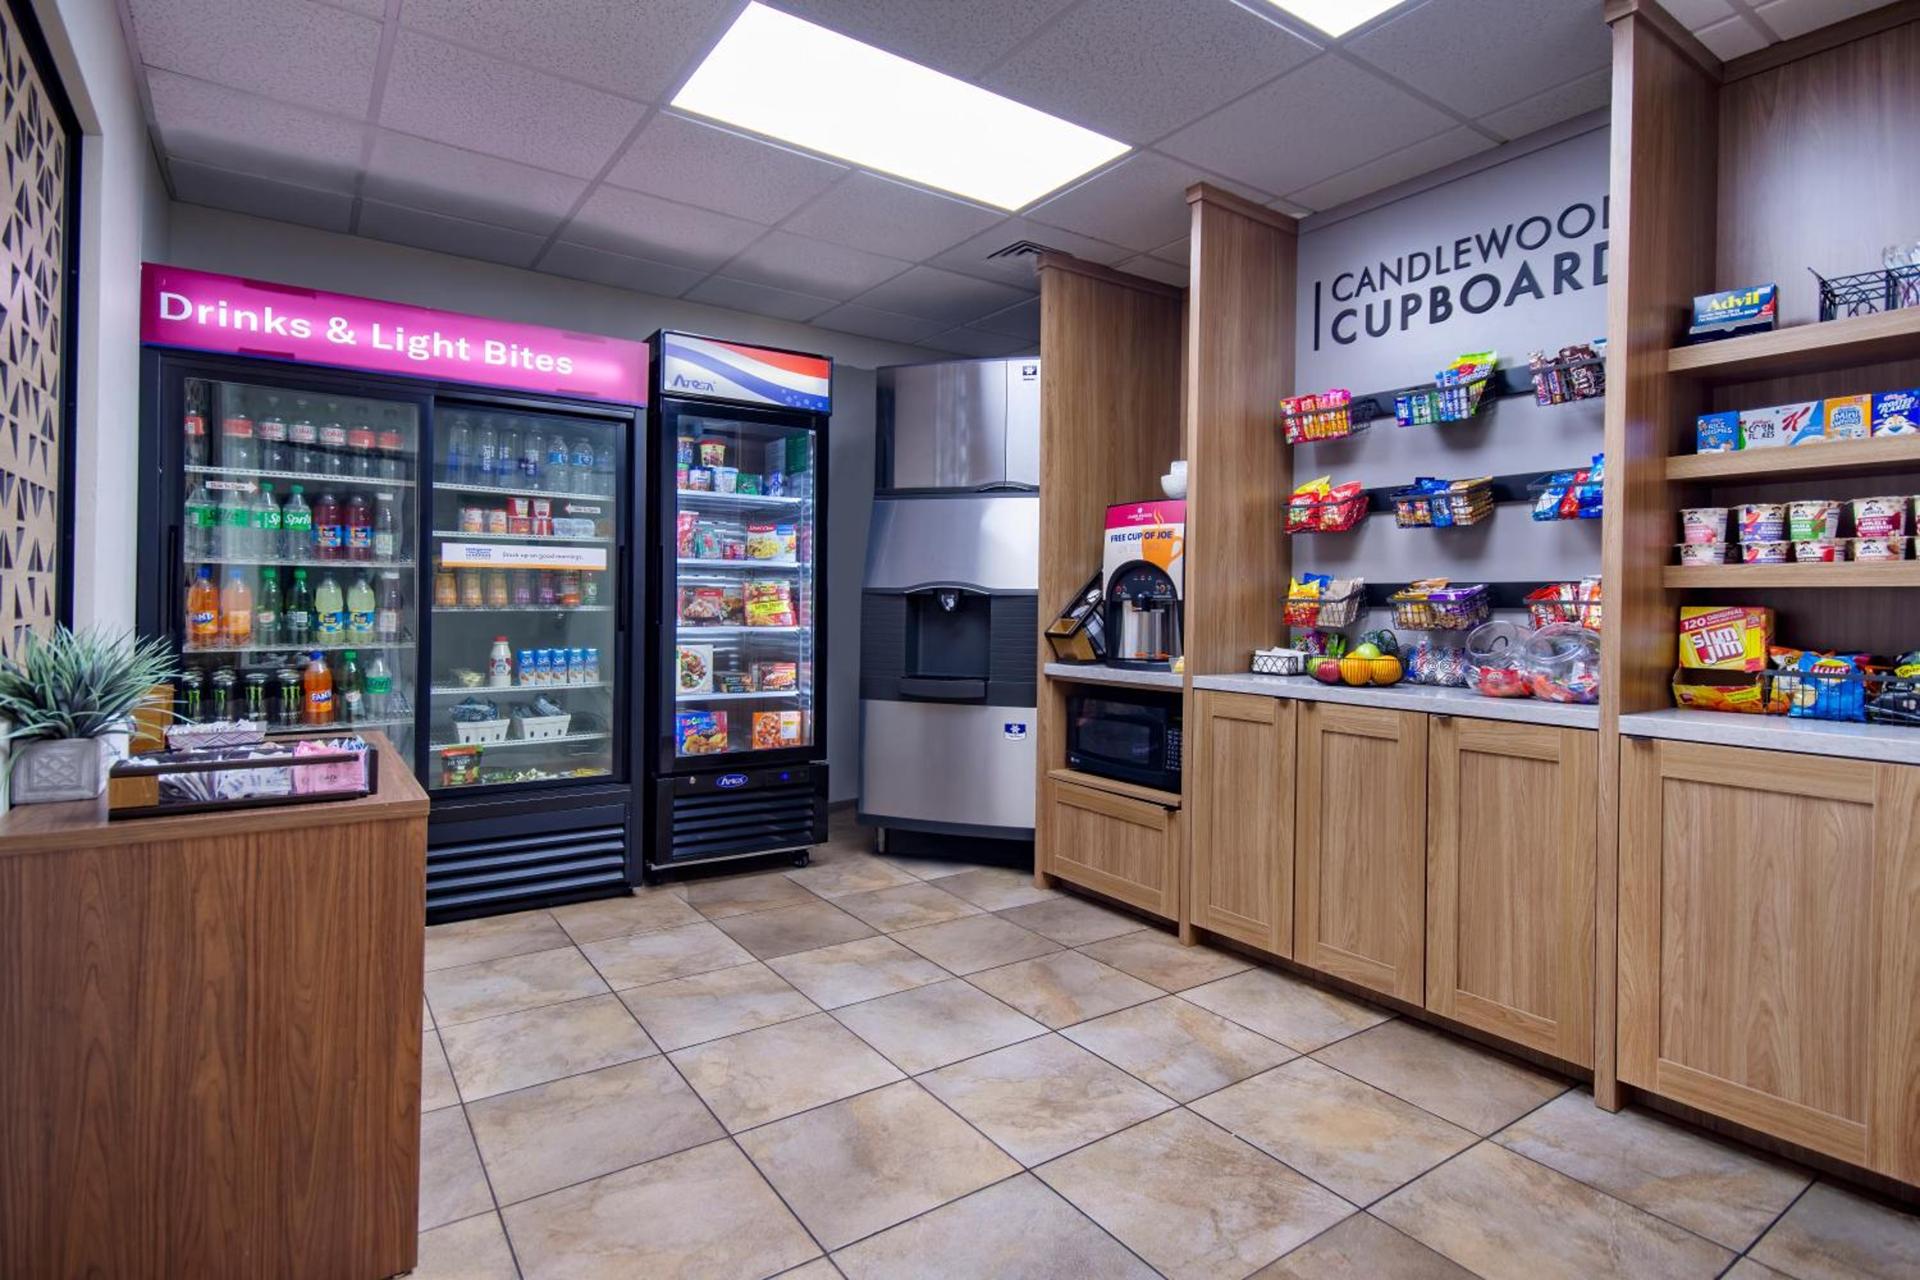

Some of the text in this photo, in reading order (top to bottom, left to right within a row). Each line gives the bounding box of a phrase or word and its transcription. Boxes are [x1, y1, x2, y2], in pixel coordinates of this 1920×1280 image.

[1332, 194, 1609, 303] CANDLEWOO
[1706, 291, 1759, 311] Advil
[159, 291, 575, 375] Drinks & Light Bites
[1110, 530, 1174, 543] FREE CUP OF JOE
[1683, 617, 1707, 631] 120
